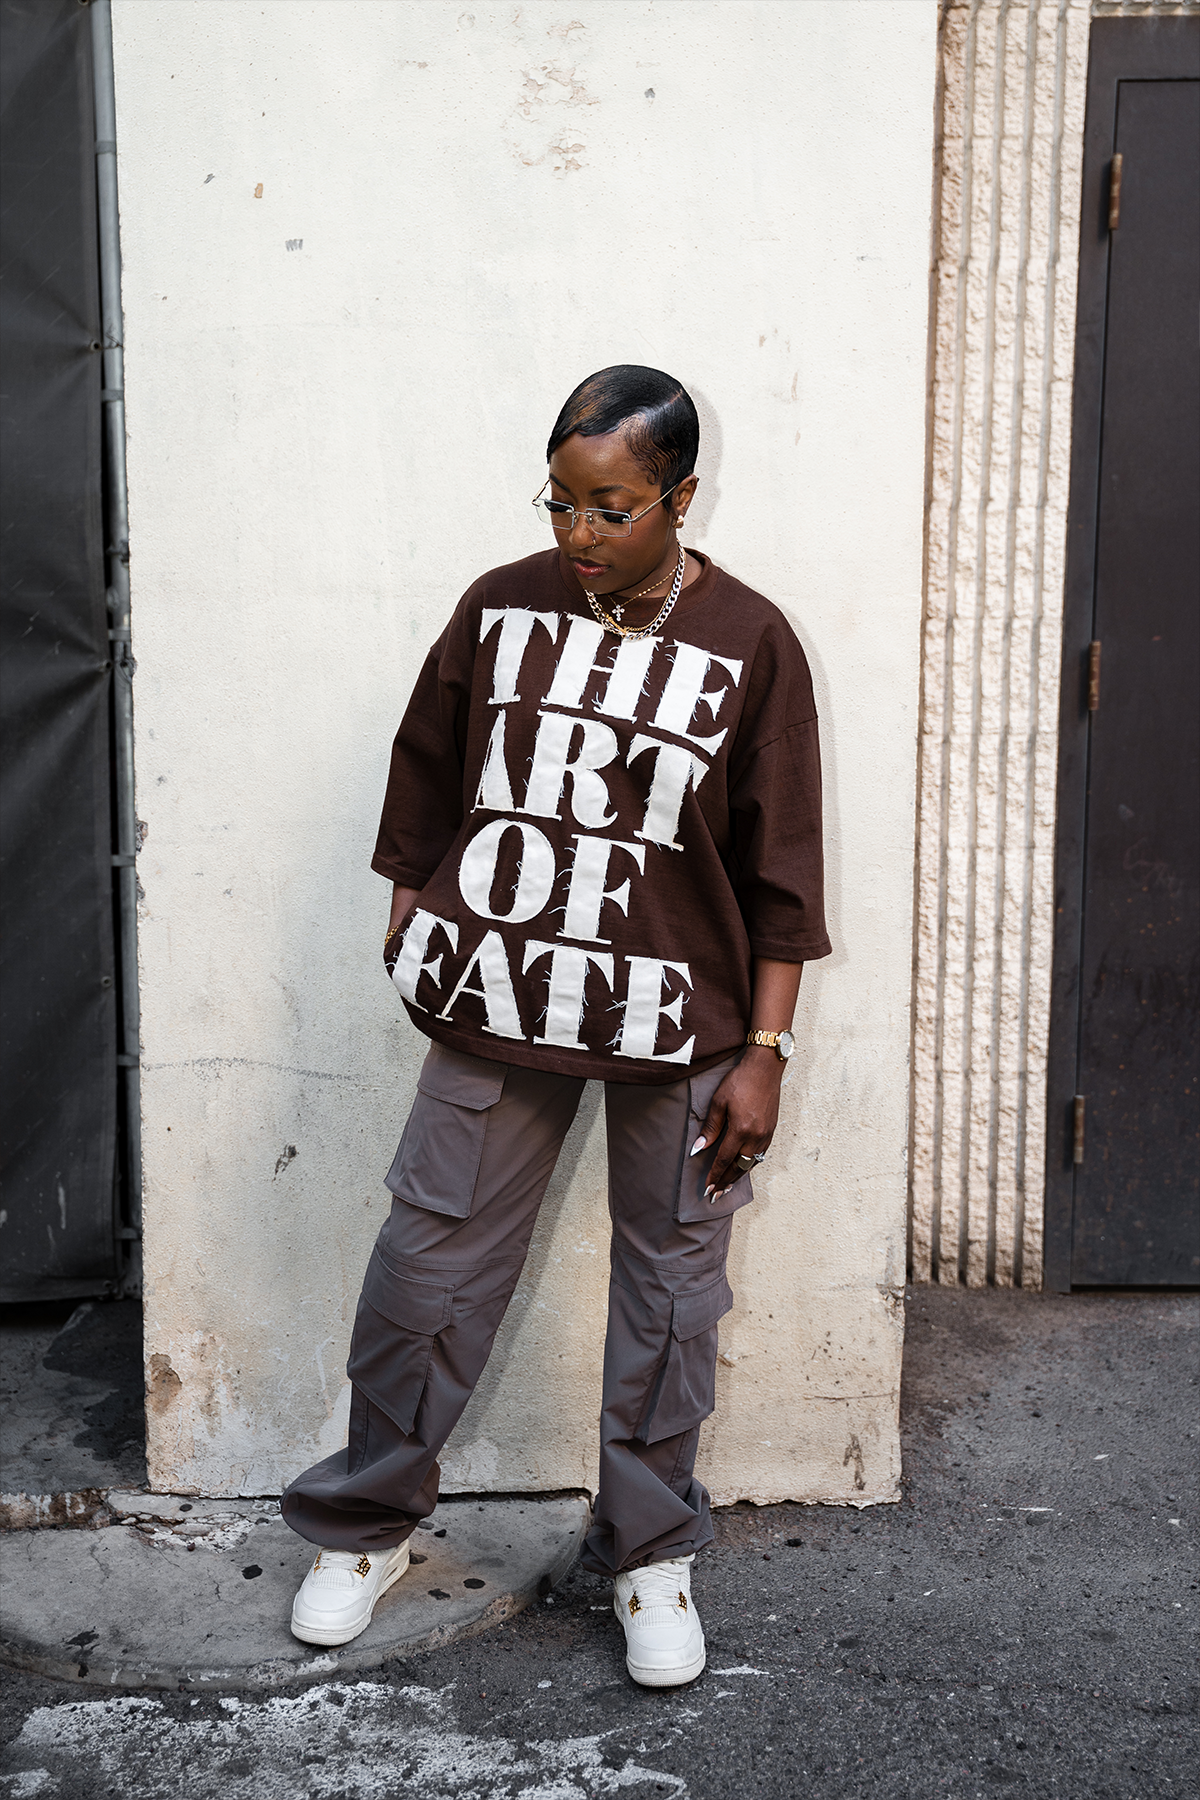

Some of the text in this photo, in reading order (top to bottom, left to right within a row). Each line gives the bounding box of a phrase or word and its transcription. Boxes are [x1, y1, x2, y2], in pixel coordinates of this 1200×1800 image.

[479, 606, 744, 756] THE
[470, 709, 710, 851] ART
[458, 818, 646, 945] OF
[389, 908, 696, 1065] FATE
